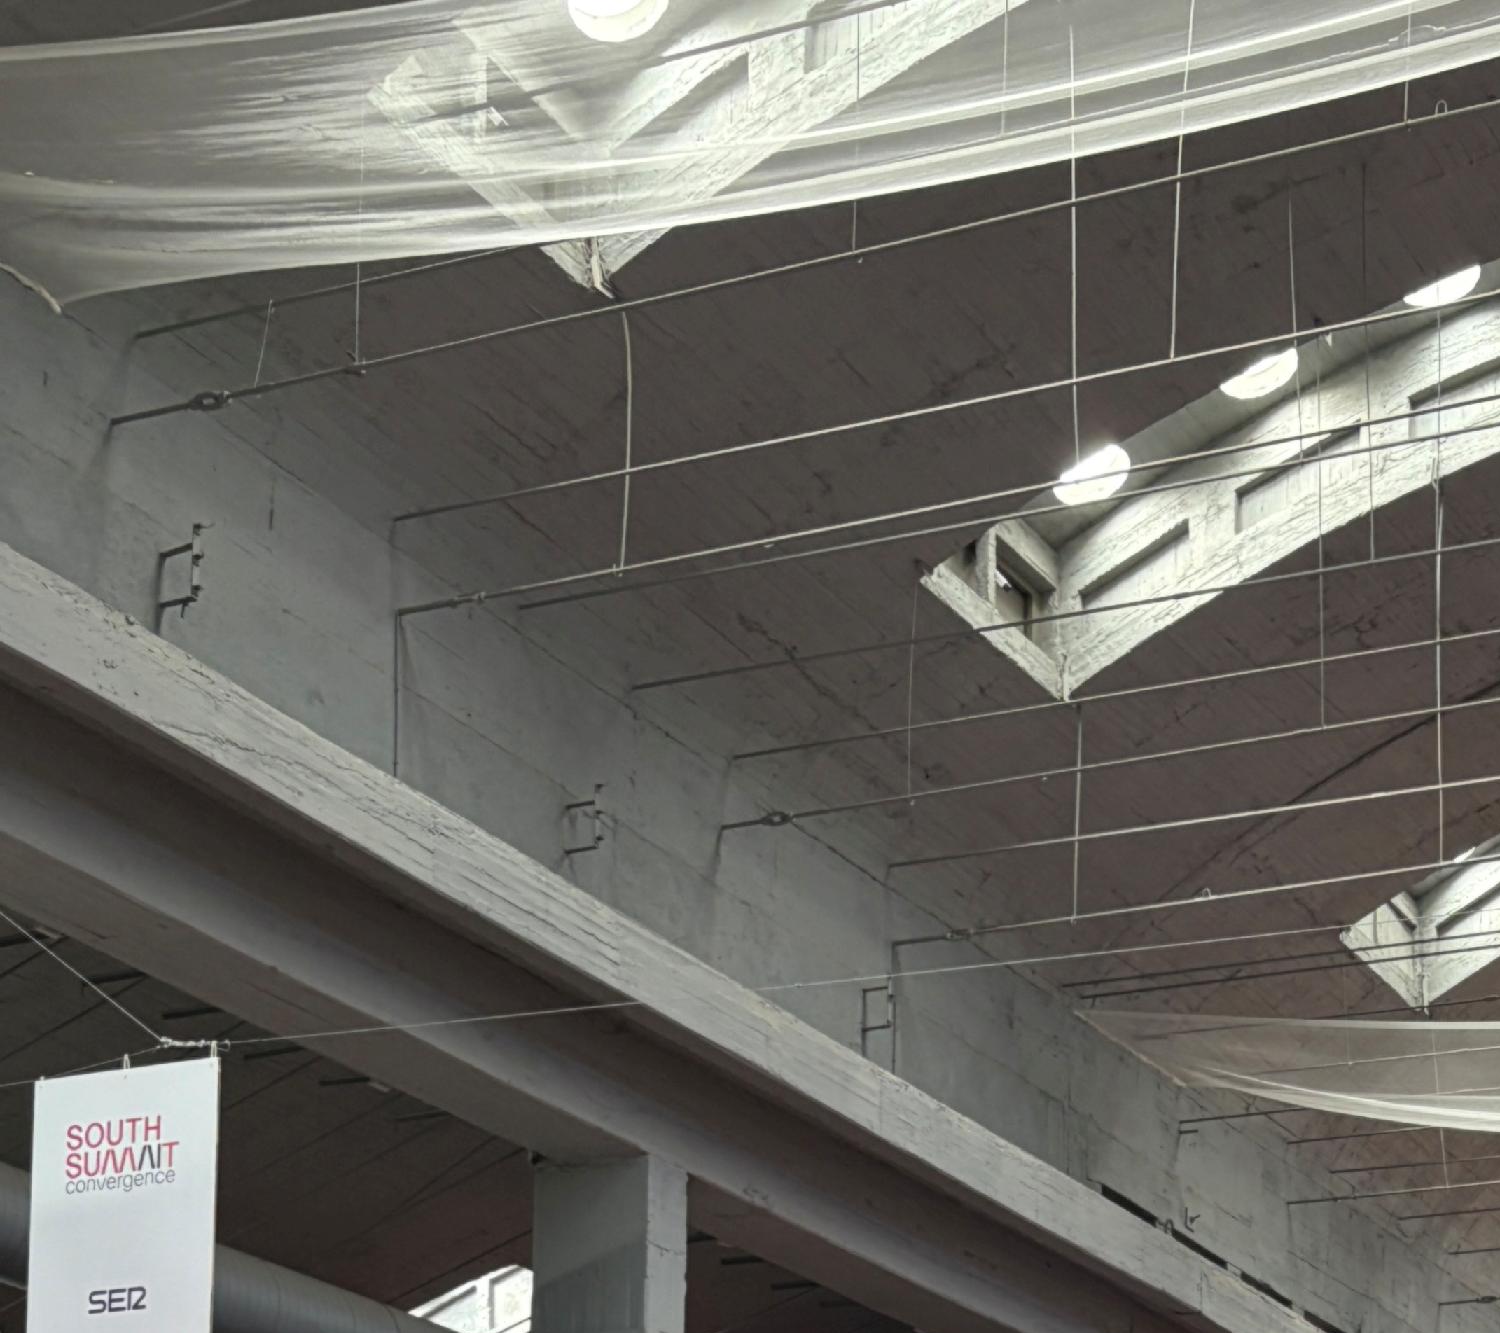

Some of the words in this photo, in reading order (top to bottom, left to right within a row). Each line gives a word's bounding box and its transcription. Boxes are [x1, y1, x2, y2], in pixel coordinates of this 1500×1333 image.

[66, 1115, 161, 1151] SOUTH
[65, 1141, 180, 1179] SUMMIT
[66, 1169, 176, 1194] convergence
[88, 1286, 147, 1314] SER
